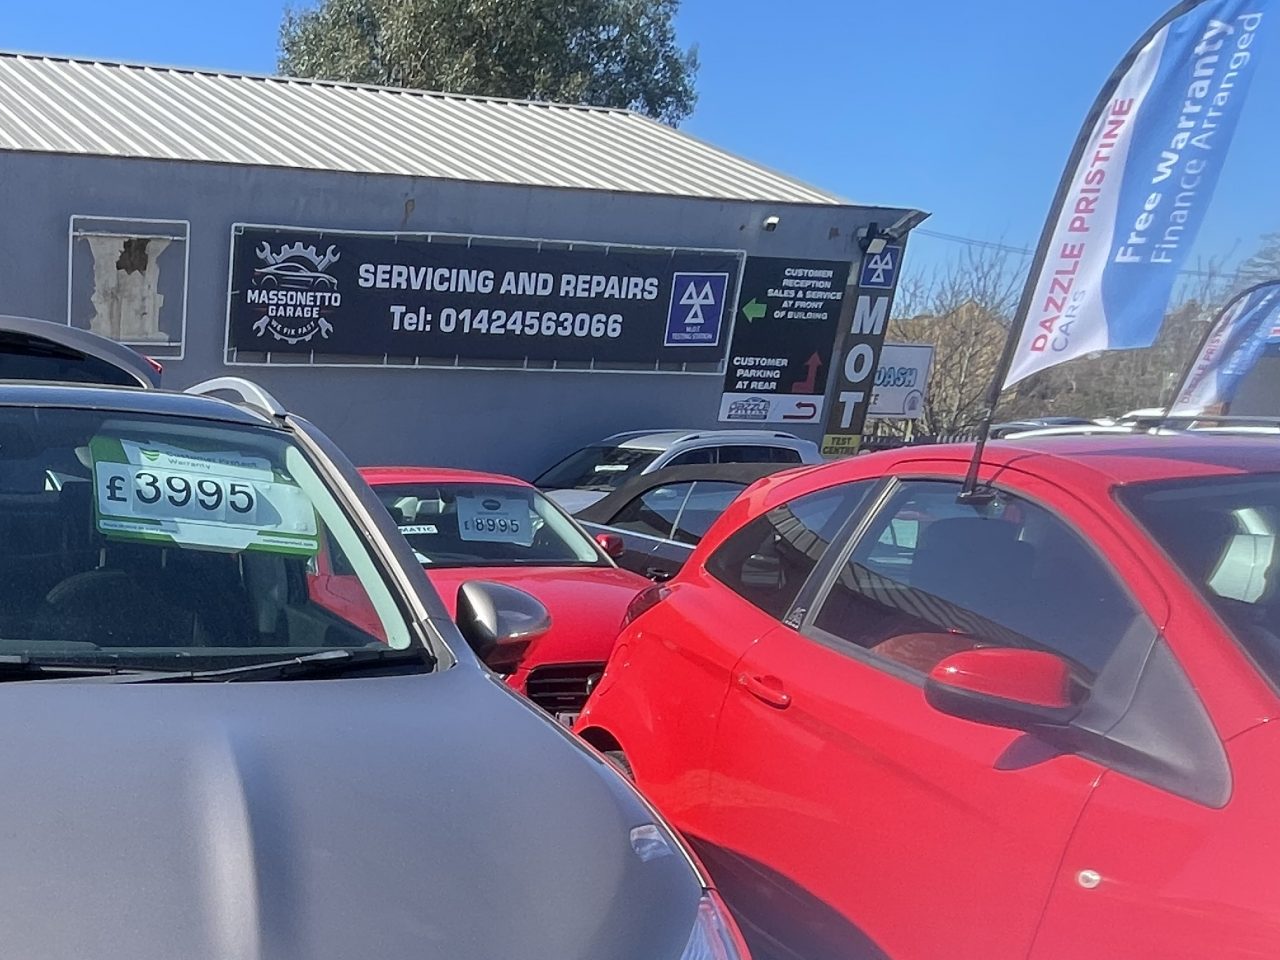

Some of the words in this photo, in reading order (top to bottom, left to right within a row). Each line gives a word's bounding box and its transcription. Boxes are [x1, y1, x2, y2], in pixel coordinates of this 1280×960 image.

[1150, 159, 1206, 263] Finance
[1190, 12, 1264, 150] Arranged
[1030, 242, 1086, 351] DAZZLE
[1067, 98, 1134, 233] PRISTINE
[1114, 191, 1162, 264] Free
[784, 267, 833, 278] CUSTOMER
[358, 263, 495, 294] SERVICING
[499, 271, 554, 296] AND
[559, 273, 659, 300] REPAIRS
[782, 279, 831, 289] RECEPTION
[247, 289, 341, 307] MASSONETTO
[767, 288, 795, 298] SALES
[806, 290, 843, 300] SERVICE
[268, 305, 320, 318] GARAGE
[782, 300, 794, 308] AT
[794, 301, 824, 309] FRONT
[389, 305, 432, 331] Tel:
[439, 307, 623, 338] 01424563066
[773, 310, 787, 319] OF
[787, 311, 828, 320] BUILDING
[1051, 290, 1086, 352] CARS
[283, 327, 296, 335] FIX
[298, 320, 315, 335] FAST
[733, 356, 789, 367] CUSTOMER
[838, 295, 889, 429] MOT
[736, 368, 781, 379] PARKING
[735, 380, 749, 389] AT
[750, 381, 777, 390] REAR
[106, 471, 255, 514] £3995
